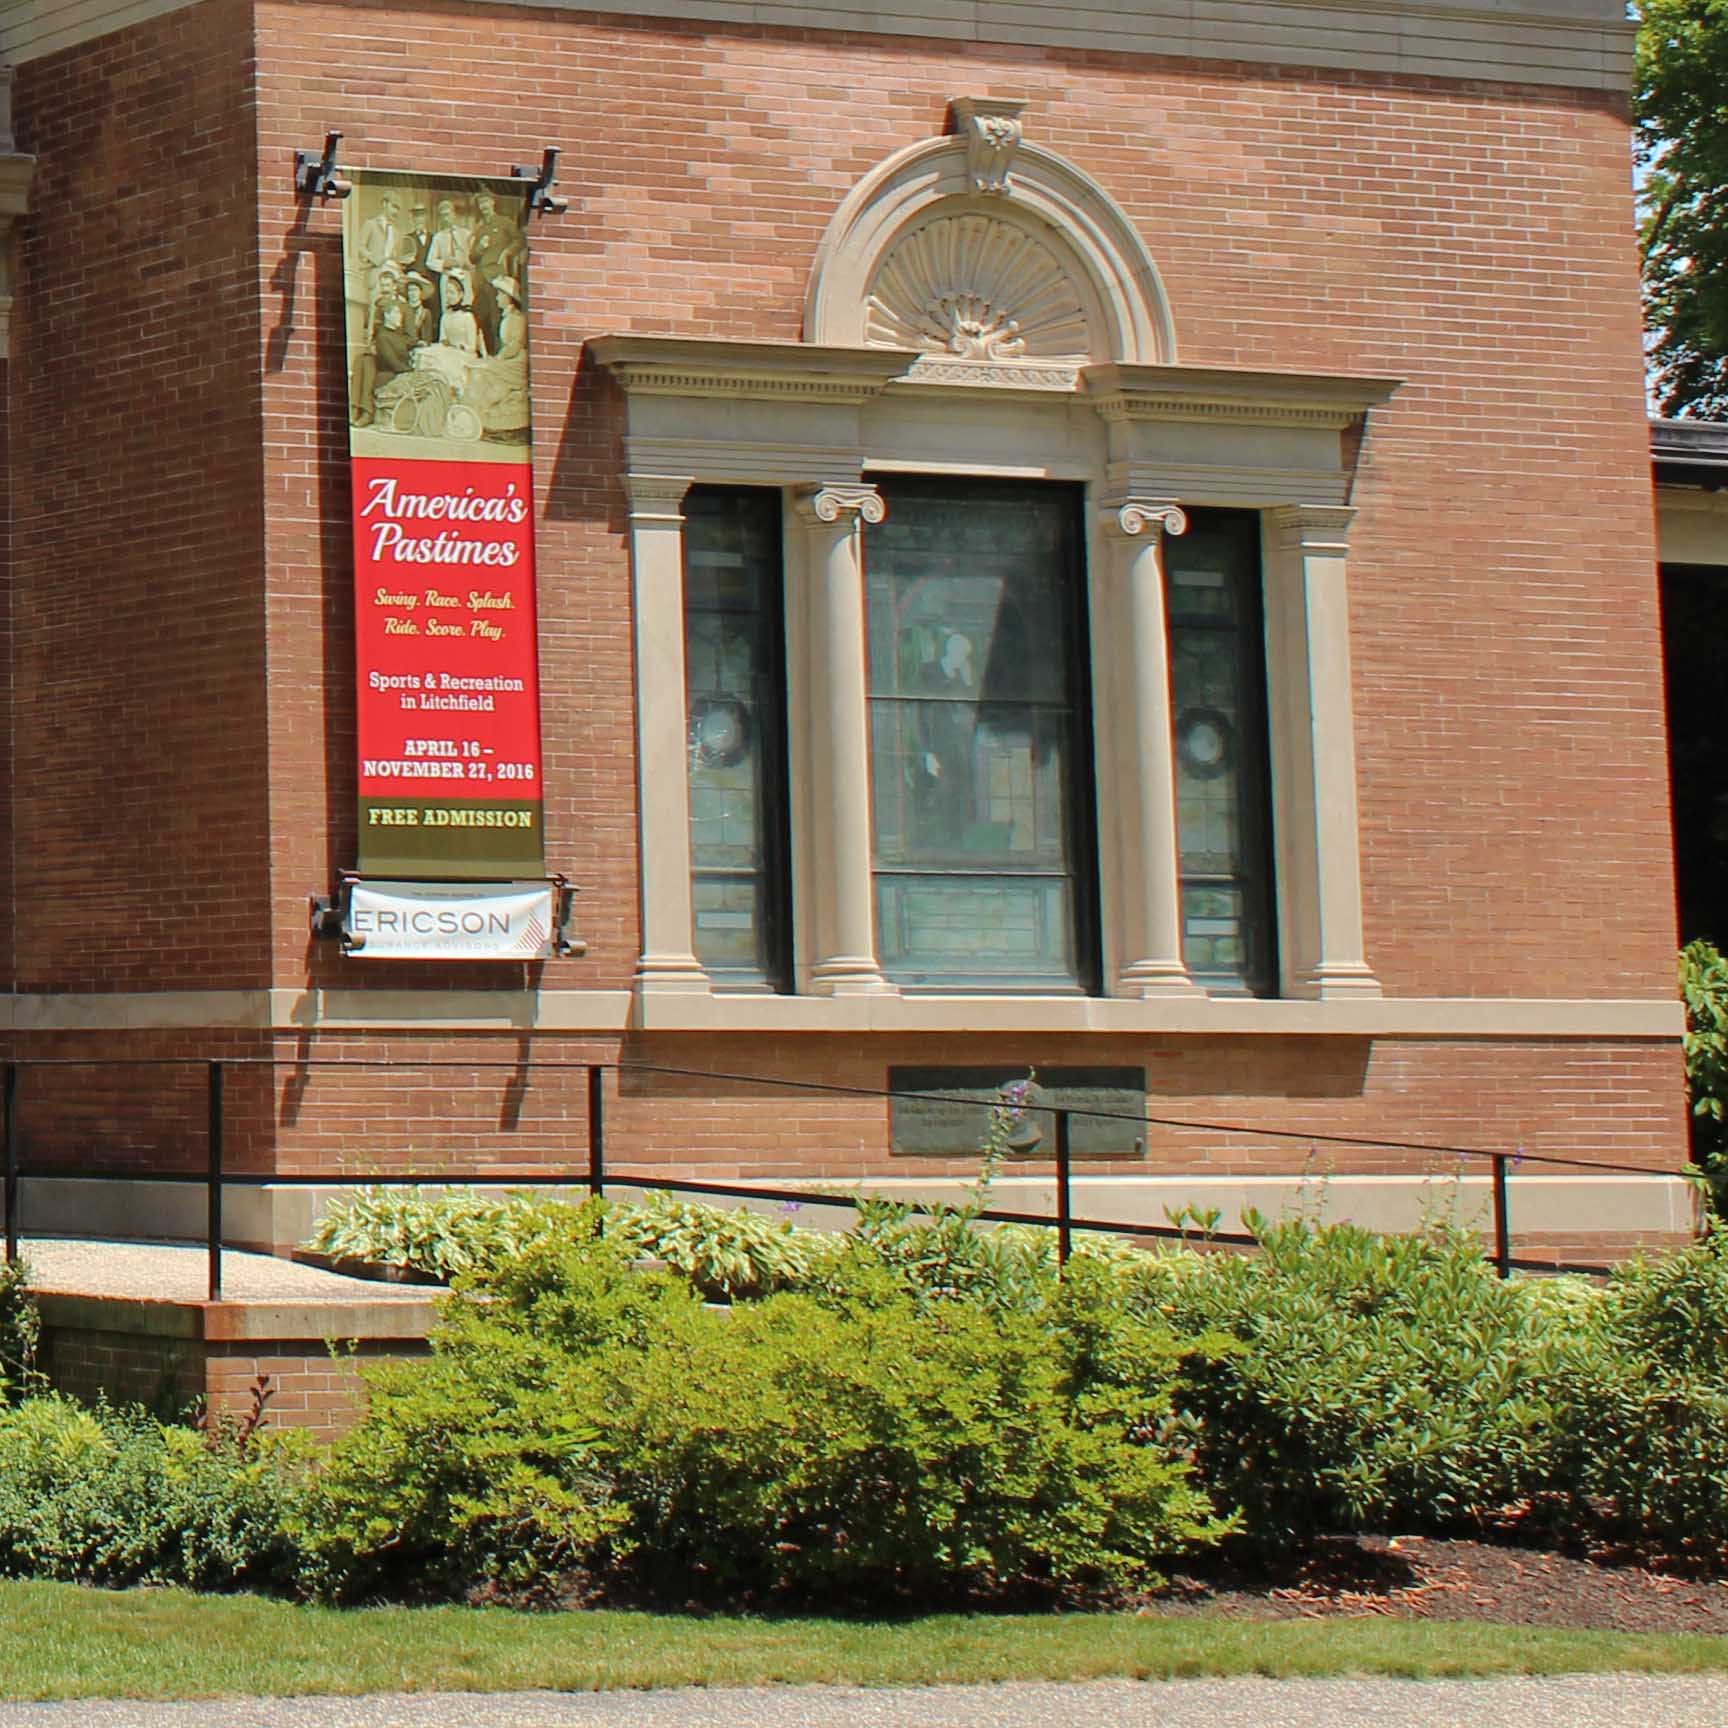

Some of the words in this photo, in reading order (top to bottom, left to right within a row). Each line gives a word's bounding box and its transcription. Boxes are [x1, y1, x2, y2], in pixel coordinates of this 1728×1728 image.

[360, 479, 528, 523] America's
[370, 522, 520, 567] Pastimes
[374, 588, 420, 610] Swing.
[424, 590, 462, 608] Race.
[467, 592, 515, 612] Splash.
[384, 618, 420, 635] Ride.
[425, 619, 465, 637] Score.
[470, 621, 506, 641] Play.
[369, 672, 421, 692] Sports
[424, 674, 436, 689] &
[440, 674, 524, 691] Recreation
[401, 694, 416, 709] in
[420, 694, 494, 711] Litchfield
[404, 740, 457, 757] APRIL
[462, 742, 480, 757] 16
[363, 761, 464, 778] NOVEMBER
[468, 763, 492, 782] 27,
[497, 764, 534, 779] 2016
[368, 808, 417, 825] FREE
[423, 809, 532, 827] ADMISSION
[355, 910, 511, 934] ERICSON
